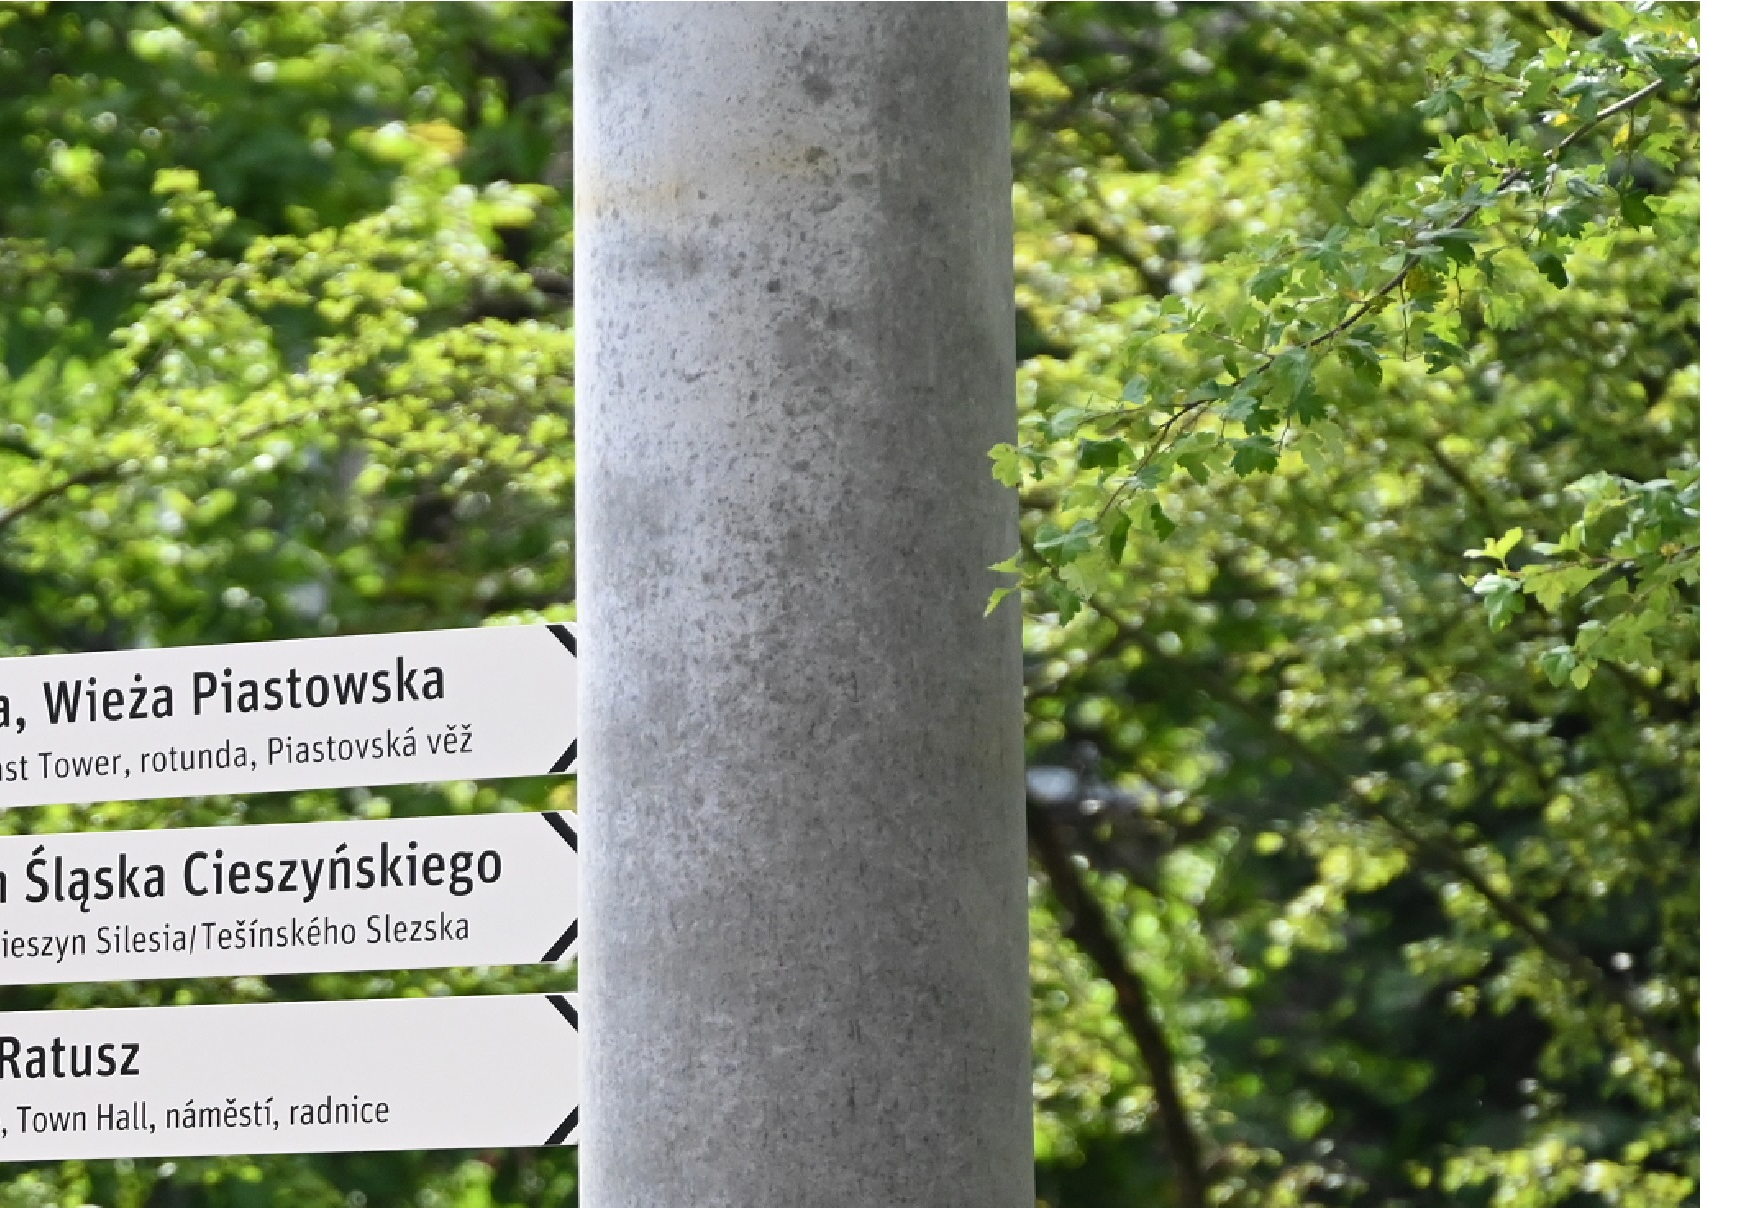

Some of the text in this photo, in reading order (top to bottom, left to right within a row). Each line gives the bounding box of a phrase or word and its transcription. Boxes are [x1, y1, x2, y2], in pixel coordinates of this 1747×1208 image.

[43, 672, 173, 725] Wieża
[192, 656, 445, 716] Piastowska
[38, 752, 130, 779] Tower,
[141, 738, 256, 773] rotunda,
[267, 726, 417, 766] Piastovská
[426, 723, 473, 755] věž
[25, 844, 164, 913] Śląska
[184, 840, 502, 904] Cieszyńskiego
[95, 916, 356, 956] Silesia/Tešínského
[366, 911, 469, 944] Slezska
[16, 1105, 86, 1134] Town
[97, 1100, 156, 1135] Hall,
[166, 1097, 279, 1131] náměstí,
[290, 1094, 389, 1126] radnice
